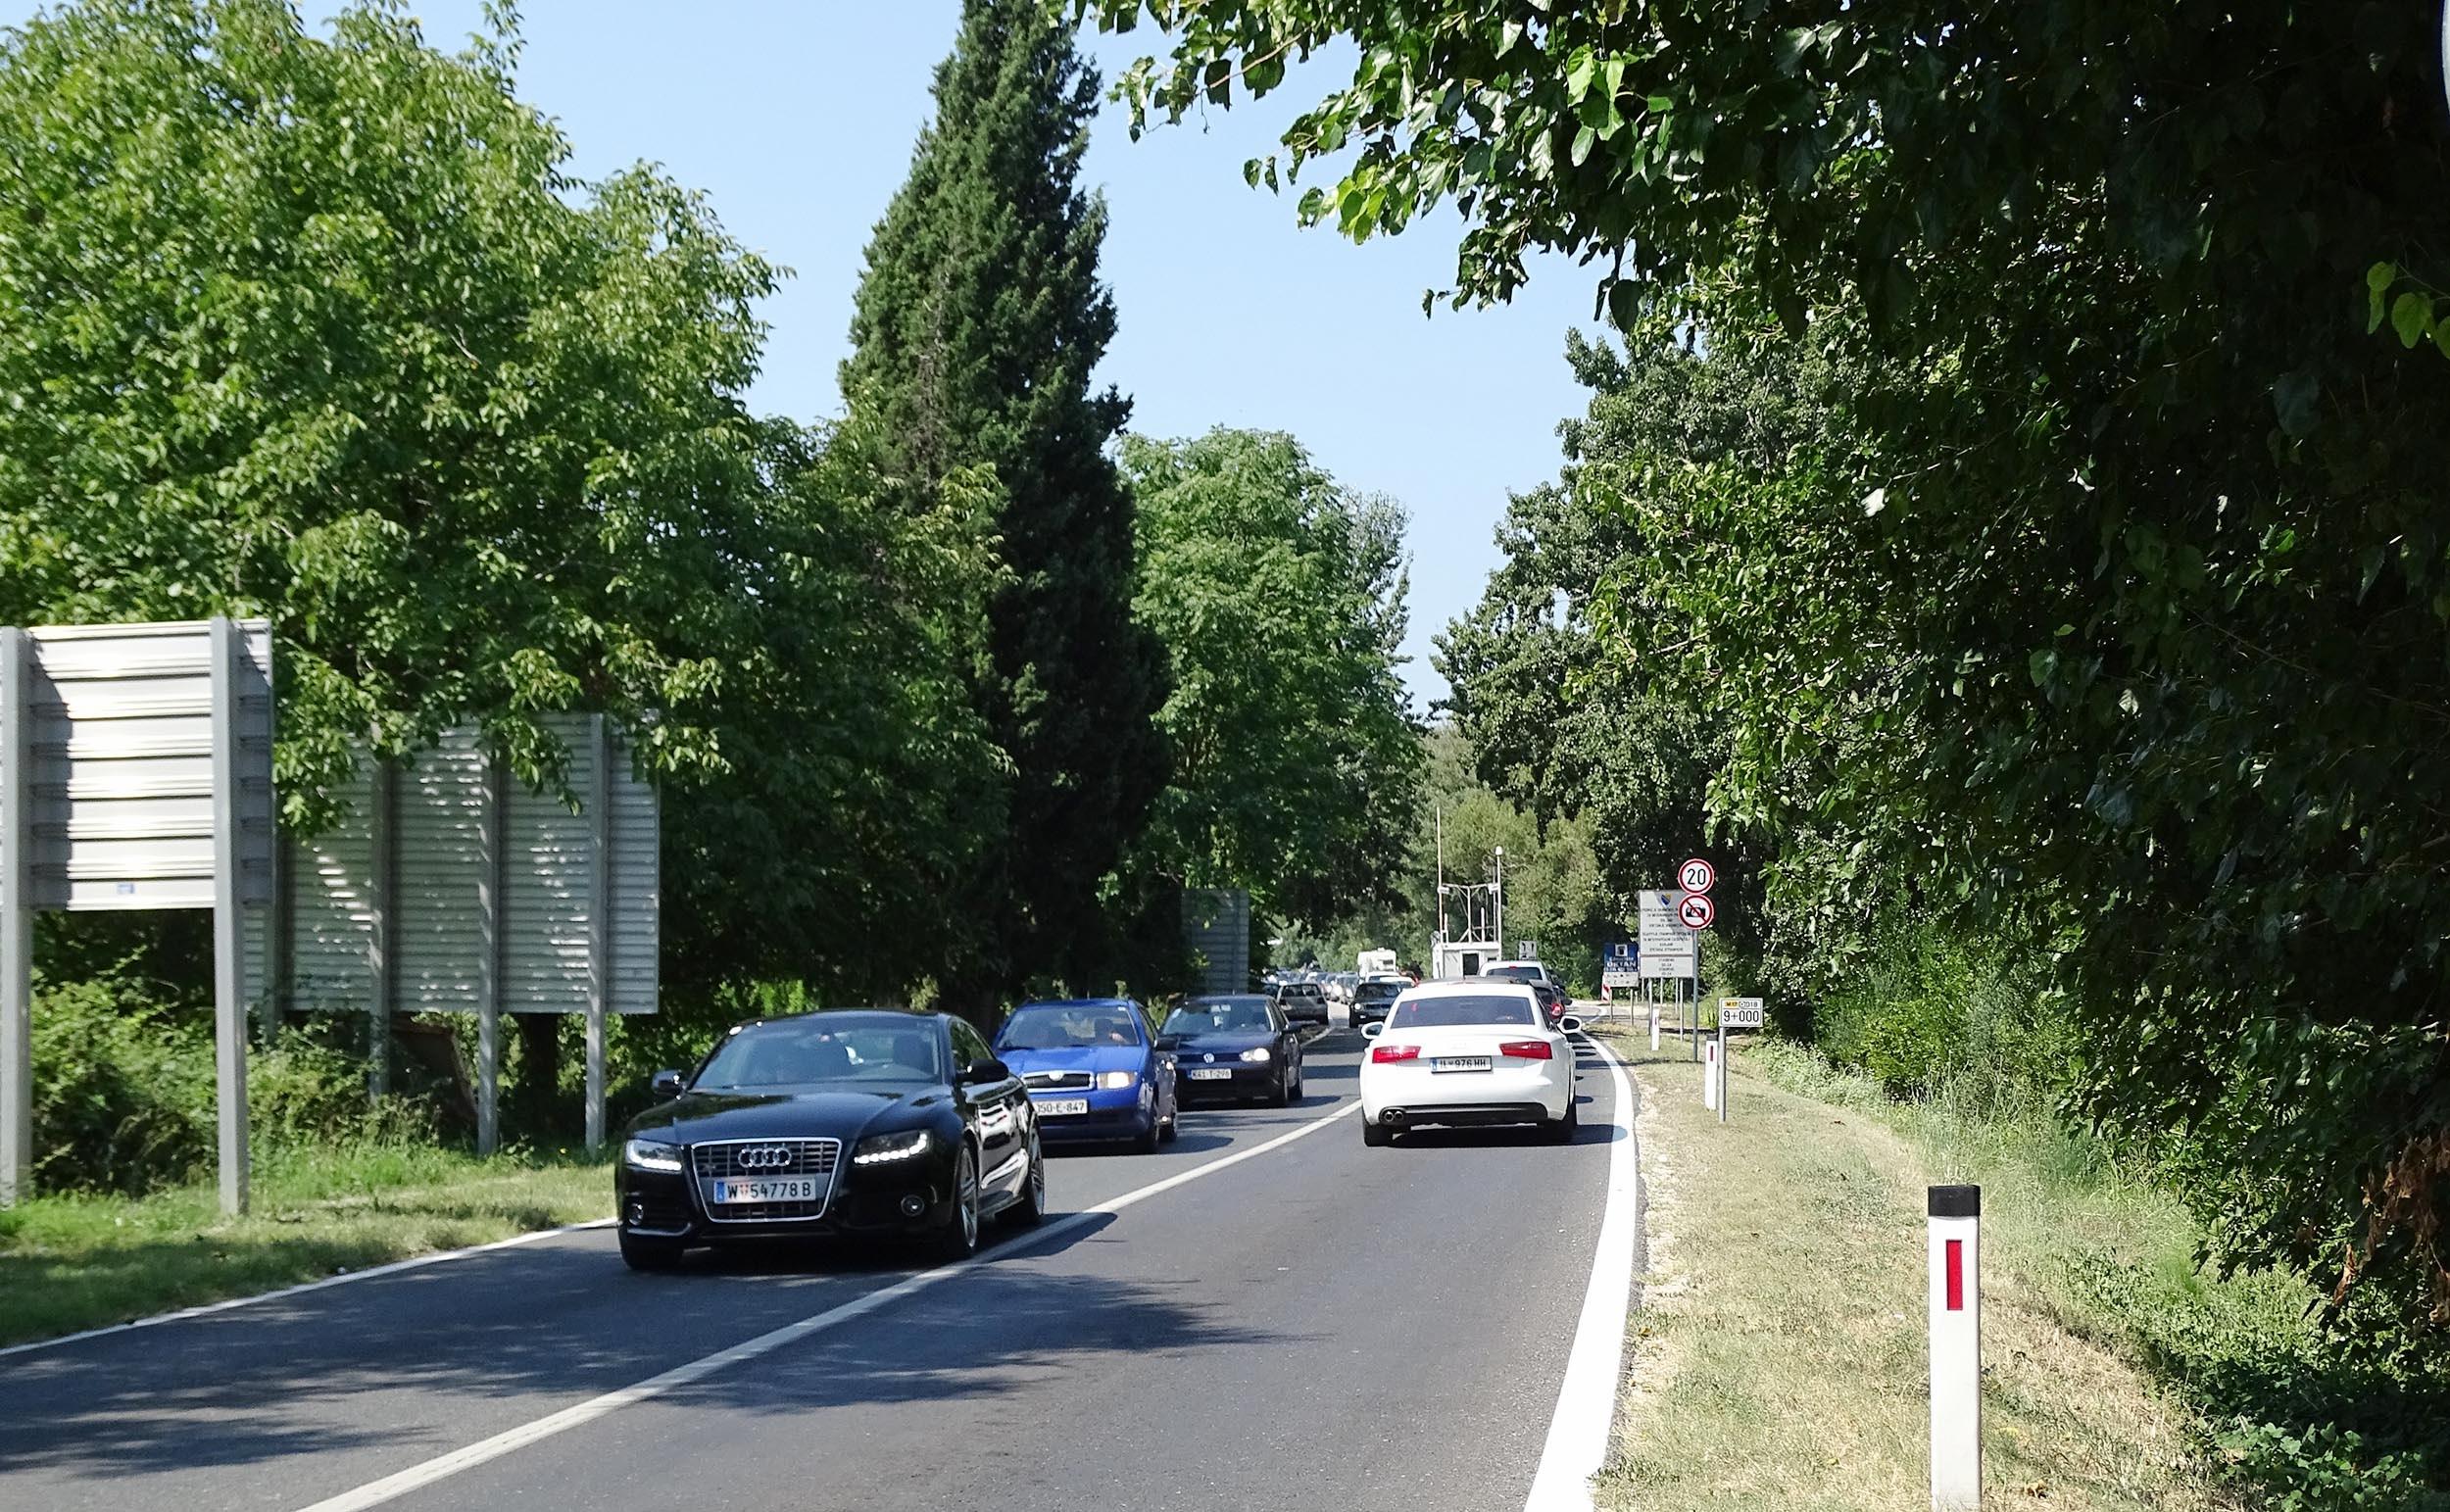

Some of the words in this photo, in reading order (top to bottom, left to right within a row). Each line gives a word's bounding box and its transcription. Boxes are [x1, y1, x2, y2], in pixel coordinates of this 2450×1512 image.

[1687, 868, 1706, 885] 20
[1724, 1010, 1759, 1022] 9+000
[727, 1184, 738, 1198] W
[750, 1182, 798, 1198] 54778
[803, 1182, 811, 1197] B
